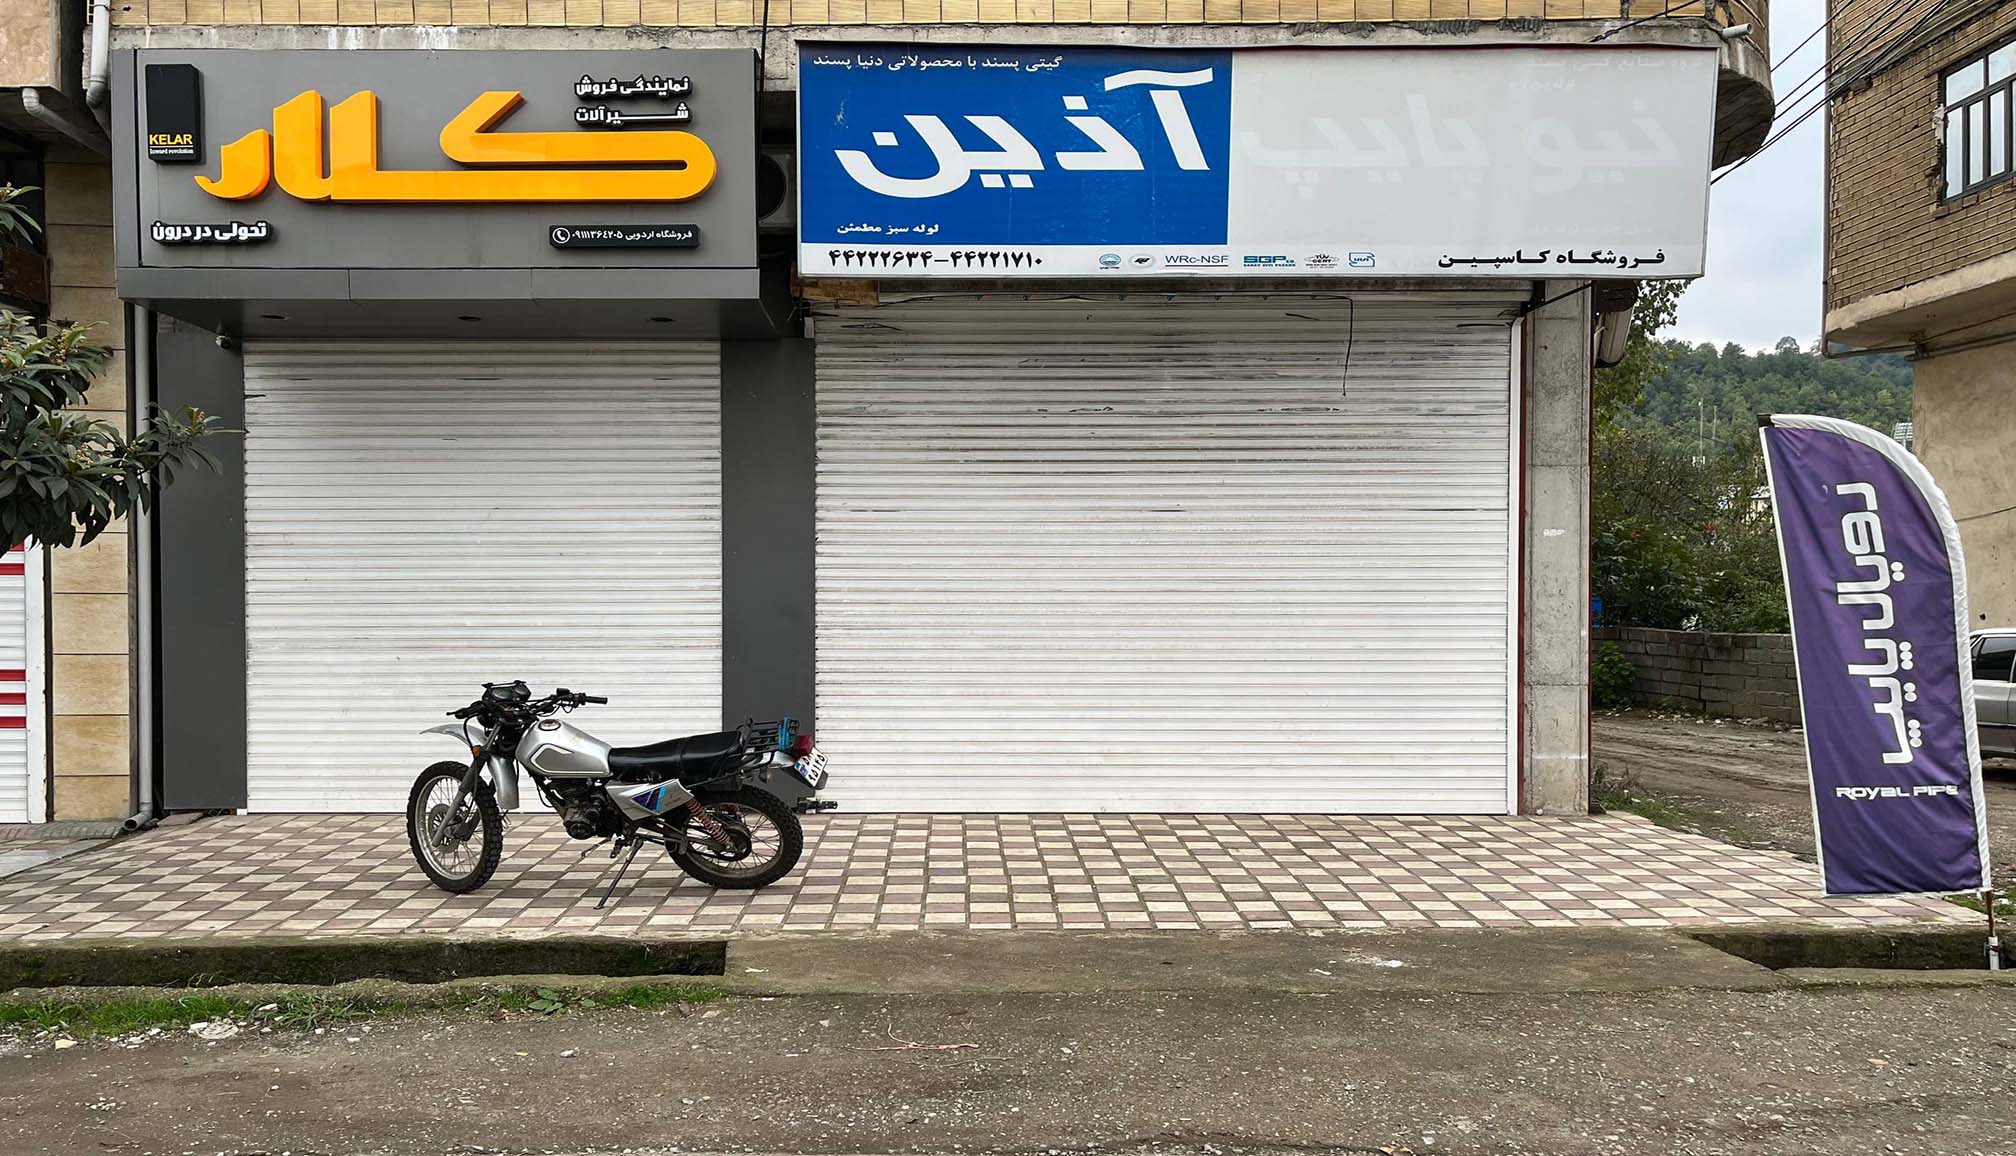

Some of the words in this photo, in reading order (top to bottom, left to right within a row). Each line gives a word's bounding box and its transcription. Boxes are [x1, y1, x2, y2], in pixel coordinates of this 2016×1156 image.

[813, 56, 851, 70] پسند
[857, 55, 883, 67] دنیا
[888, 55, 962, 71] محصولاتی
[967, 56, 977, 69] با
[982, 57, 1019, 71] پسند
[1025, 55, 1063, 71] گیتی
[576, 76, 617, 95] فروش
[620, 77, 689, 96] نمایندگی
[149, 134, 193, 145] KELAR
[833, 67, 1212, 198] آذین
[195, 89, 716, 203] کلار
[152, 222, 192, 240] درون
[193, 226, 212, 240] در
[214, 222, 267, 240] تحولی
[625, 229, 655, 241] اردویی
[656, 229, 693, 240] فروشگاه
[837, 223, 882, 234] مطمئن
[886, 225, 909, 235] سبز
[913, 224, 939, 235] لوله
[1165, 255, 1229, 264] WRc-NSF
[1243, 255, 1286, 263] SGP
[1438, 249, 1550, 269] کاسپین
[1556, 248, 1666, 268] فروشگاه
[1835, 786, 1911, 800] ROYAL
[1912, 784, 1960, 797] PIPE
